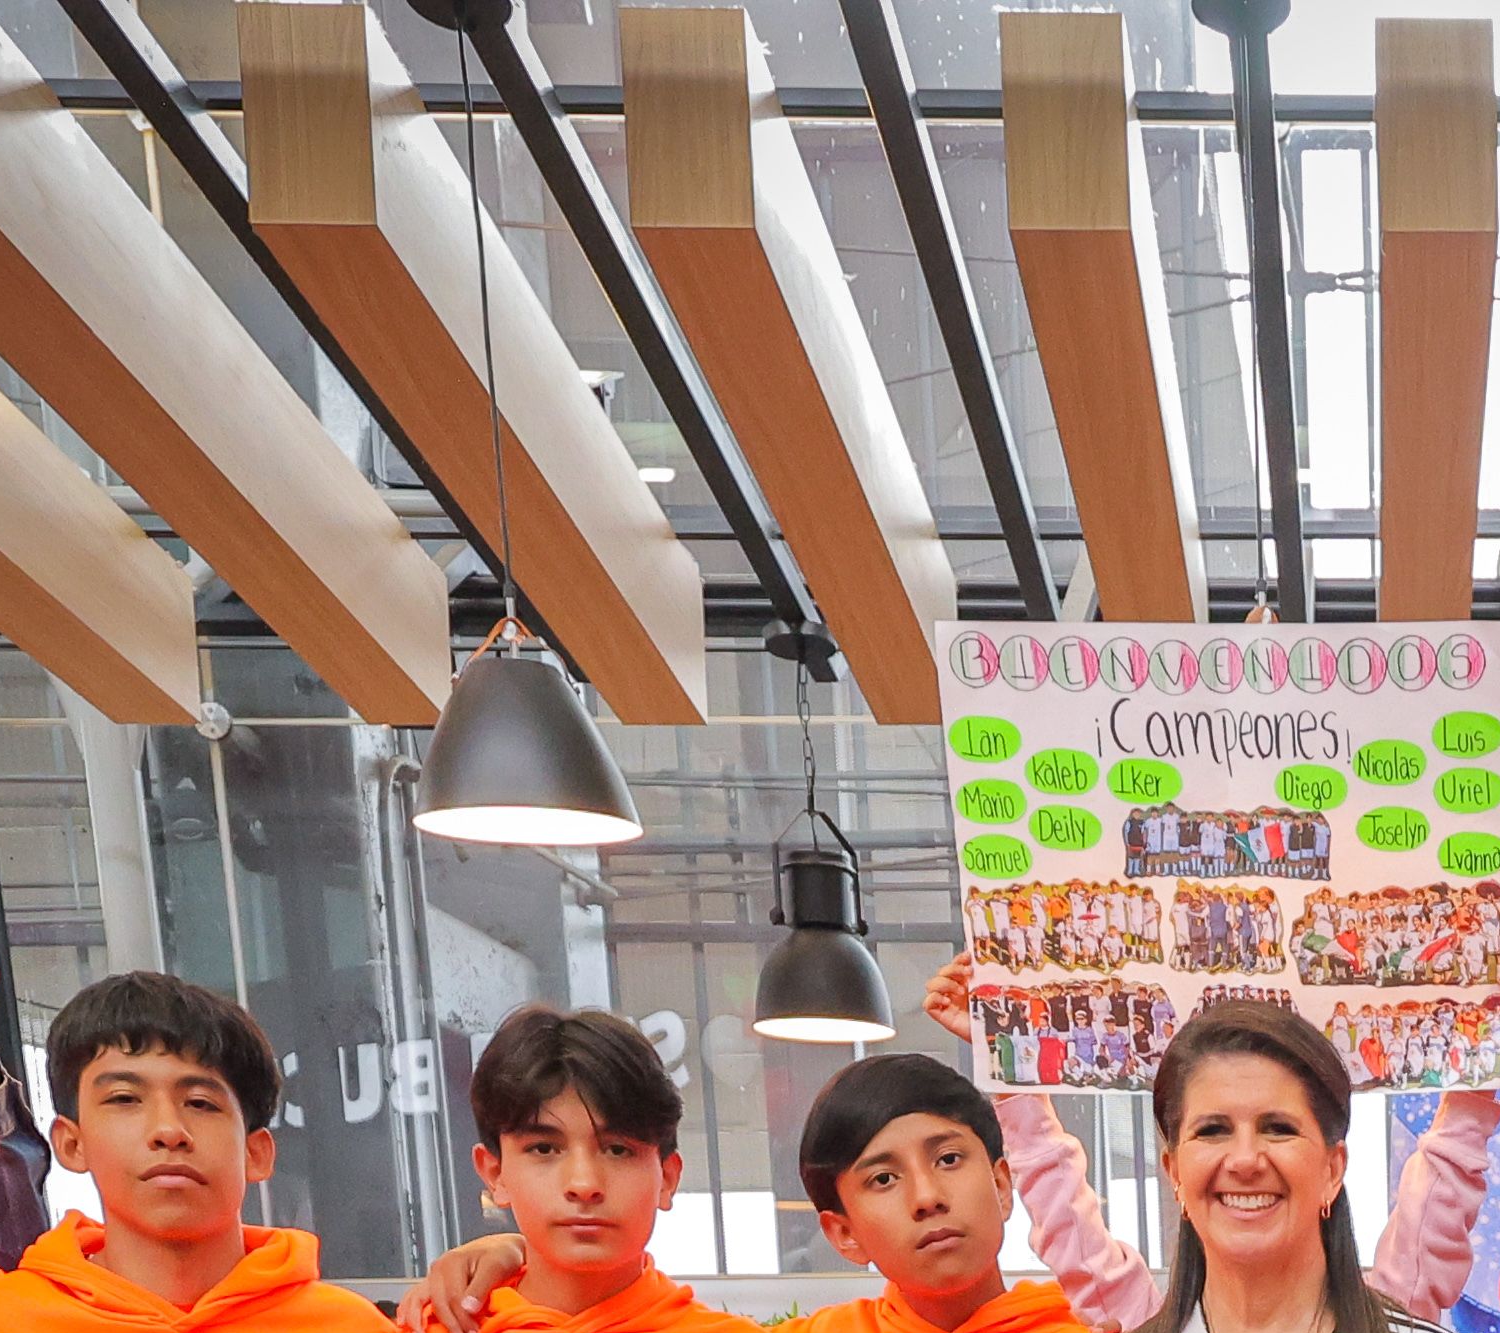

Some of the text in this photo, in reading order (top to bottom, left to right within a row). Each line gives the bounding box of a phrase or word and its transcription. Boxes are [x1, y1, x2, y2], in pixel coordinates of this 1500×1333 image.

[962, 720, 1008, 758] Ian
[1442, 716, 1487, 753] Luis
[1031, 752, 1088, 791] Kaleb
[1113, 763, 1163, 798] Iker
[1357, 746, 1421, 783] Nicolas
[963, 786, 1016, 820] Mario
[1283, 770, 1333, 810] Diego
[1441, 772, 1492, 807] Uriel
[1037, 808, 1087, 849] Deily
[1363, 811, 1428, 849] Joselyn
[963, 841, 1030, 874] Samuel
